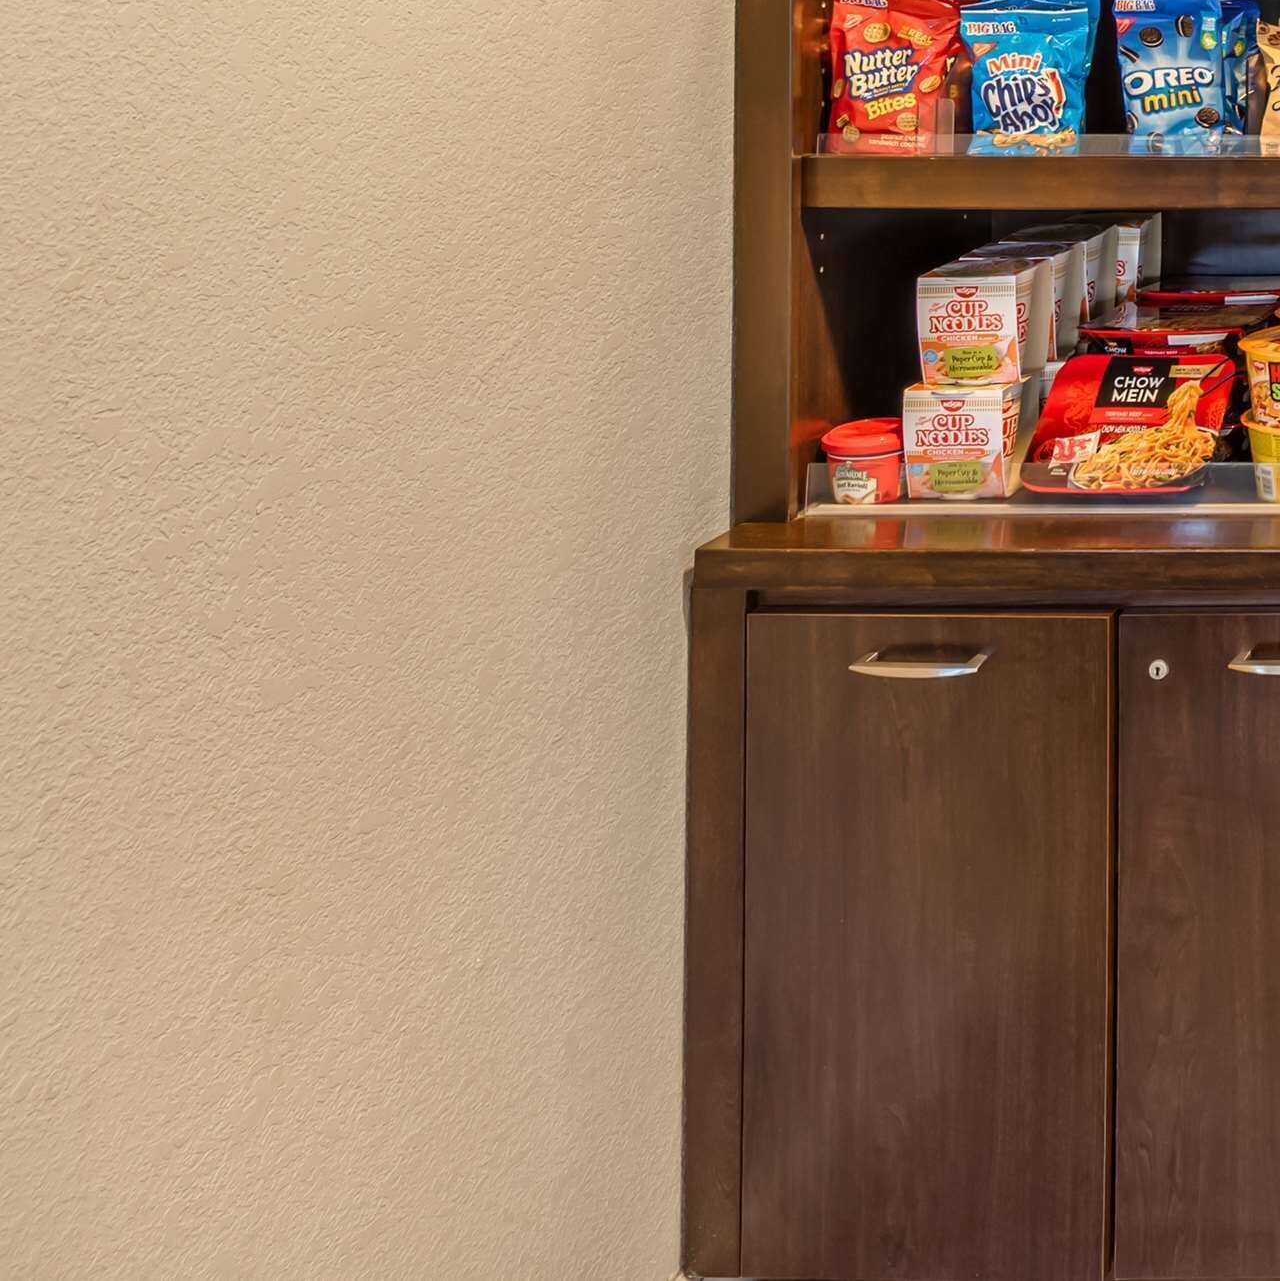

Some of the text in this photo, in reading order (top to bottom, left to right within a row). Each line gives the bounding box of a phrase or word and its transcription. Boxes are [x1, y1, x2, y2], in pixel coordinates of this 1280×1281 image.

[1116, 0, 1134, 11] BIG
[967, 21, 1015, 33] BIG BAG
[844, 48, 912, 76] Nutter
[987, 54, 1041, 75] Mini
[850, 64, 918, 96] Butter
[1124, 68, 1214, 96] OREO
[983, 75, 1051, 118] Chips
[1144, 87, 1201, 112] mini
[865, 93, 916, 120] Bites
[945, 300, 988, 317] CUP
[929, 314, 1003, 333] NOODLES
[1114, 377, 1165, 388] CHOW
[1111, 389, 1158, 402] MEIN
[932, 414, 974, 430] CUP
[916, 428, 989, 447] NOODLES
